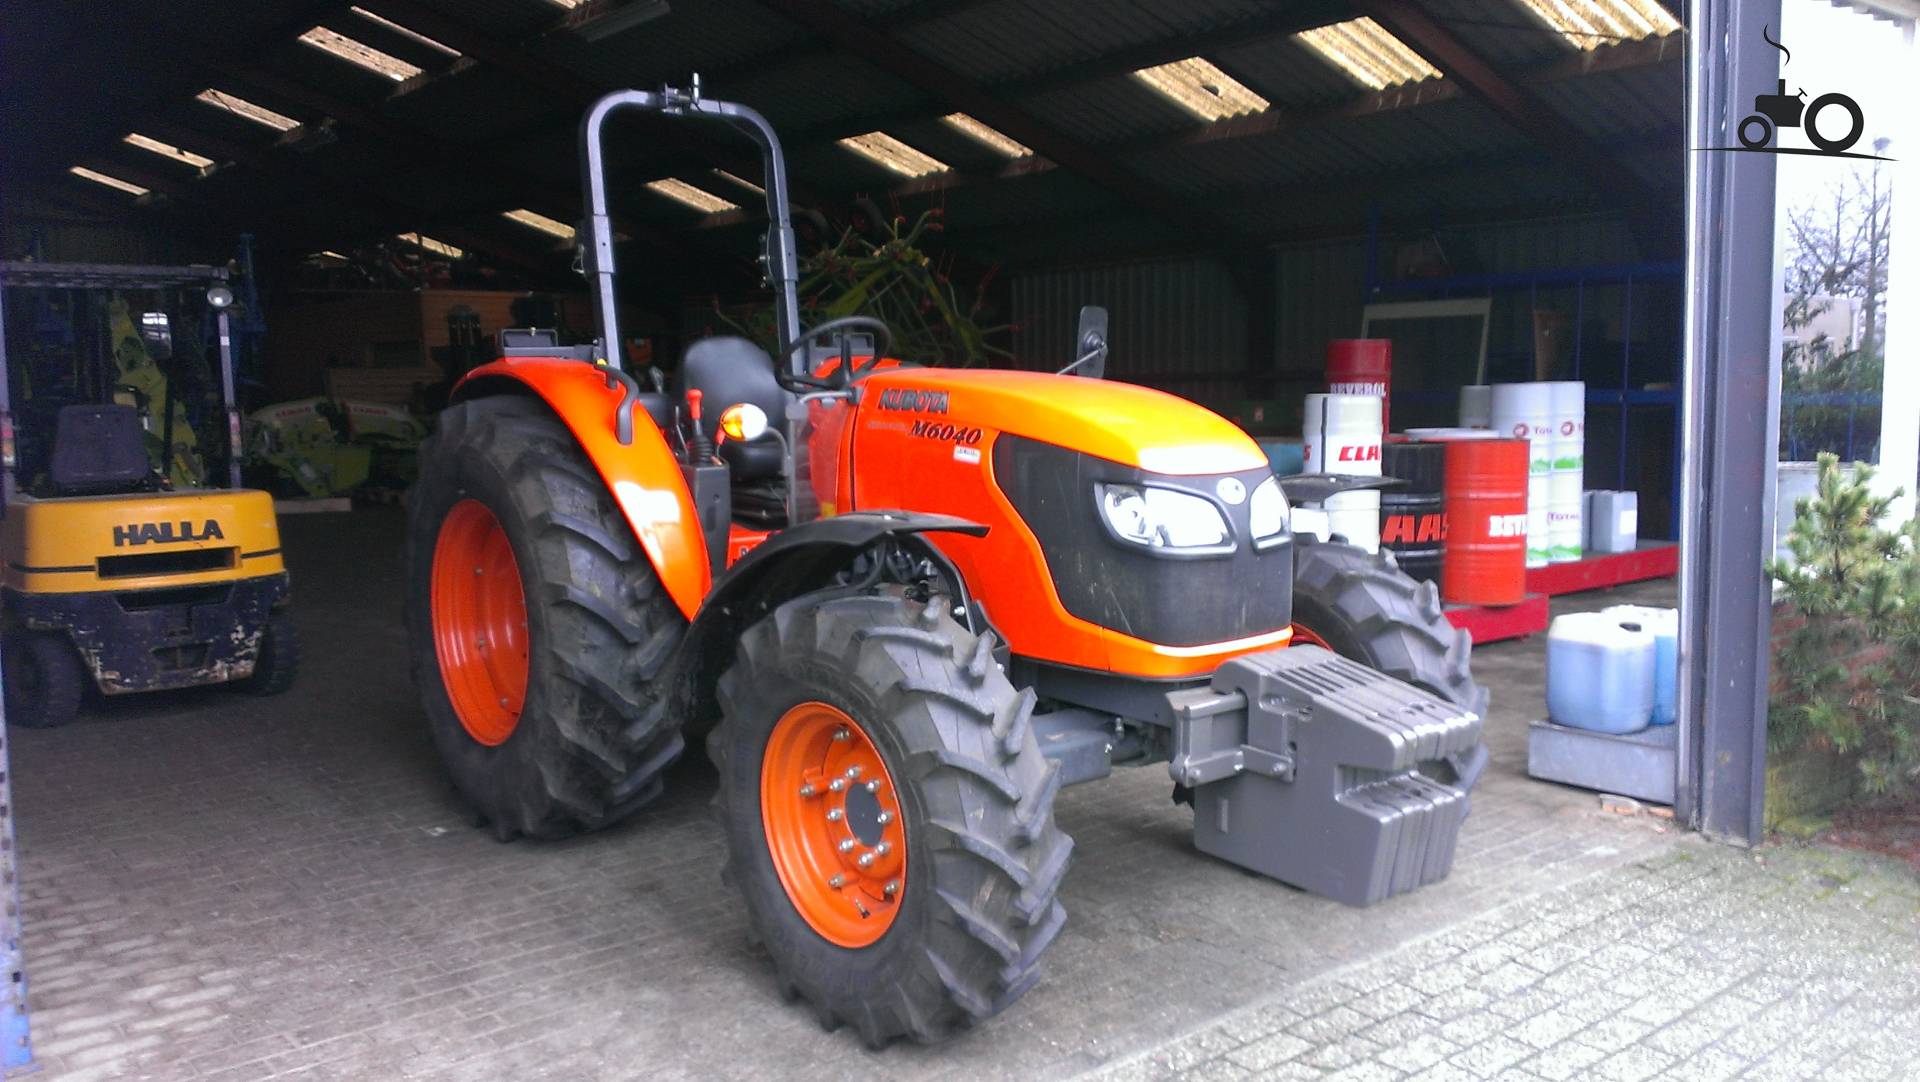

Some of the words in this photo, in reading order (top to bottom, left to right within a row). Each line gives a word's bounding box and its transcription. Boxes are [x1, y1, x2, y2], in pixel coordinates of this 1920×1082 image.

[878, 389, 949, 414] KUBOTA
[911, 420, 982, 445] M6040
[113, 519, 224, 547] HALLA
